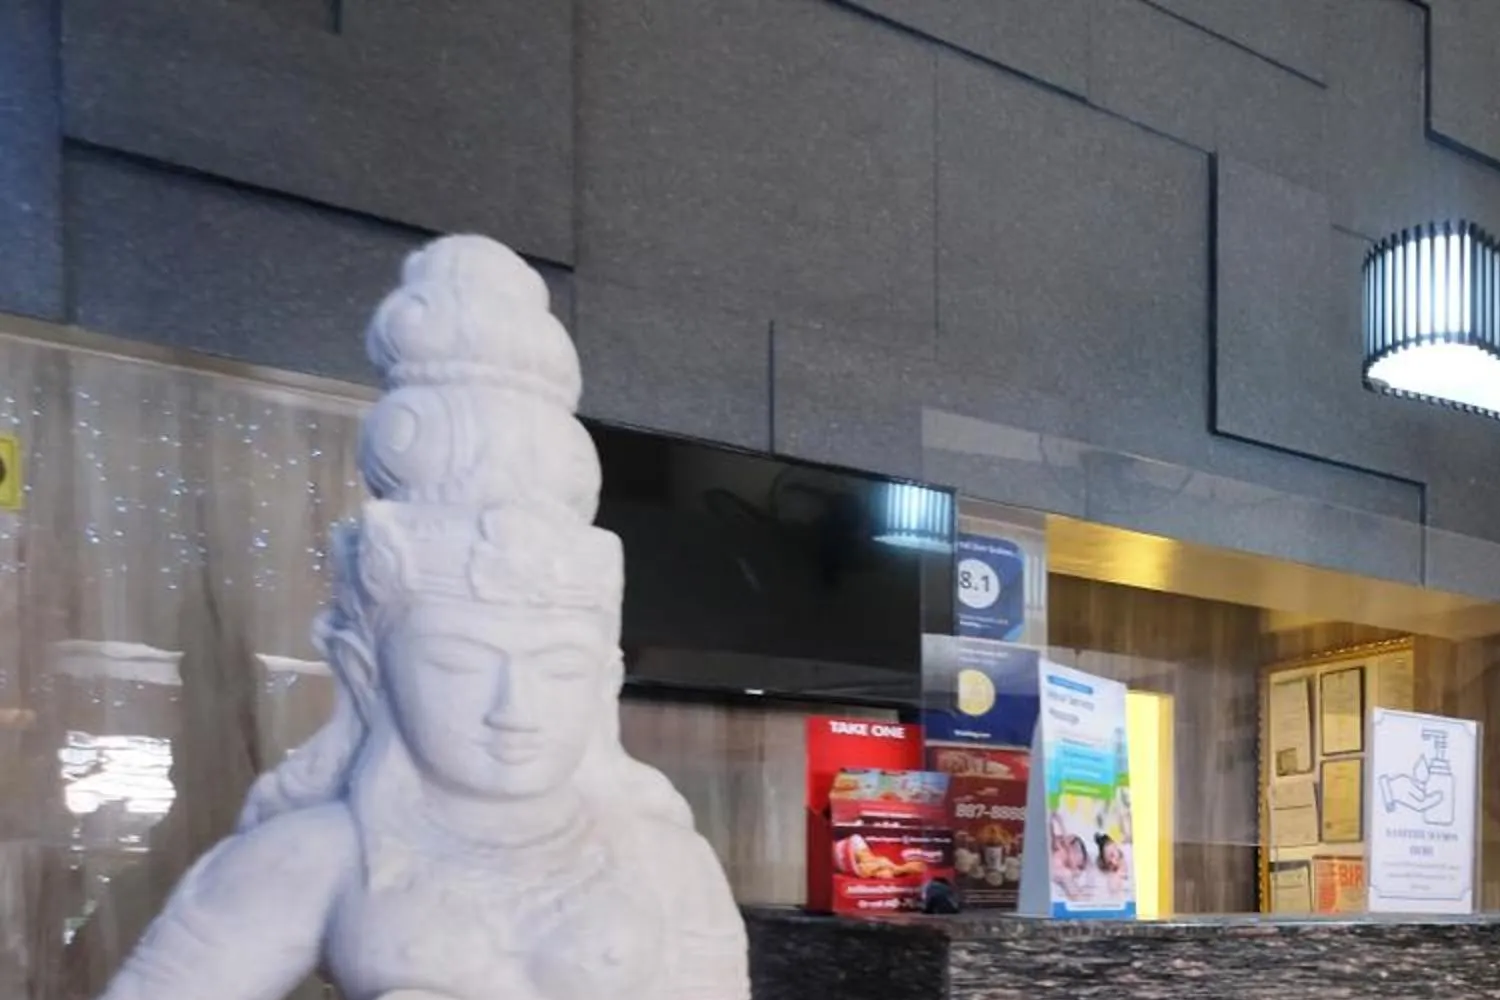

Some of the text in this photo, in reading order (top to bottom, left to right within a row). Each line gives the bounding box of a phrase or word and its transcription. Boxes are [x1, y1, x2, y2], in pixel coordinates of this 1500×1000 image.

[959, 570, 990, 593] 8.1
[828, 720, 905, 739] TAKE ONE
